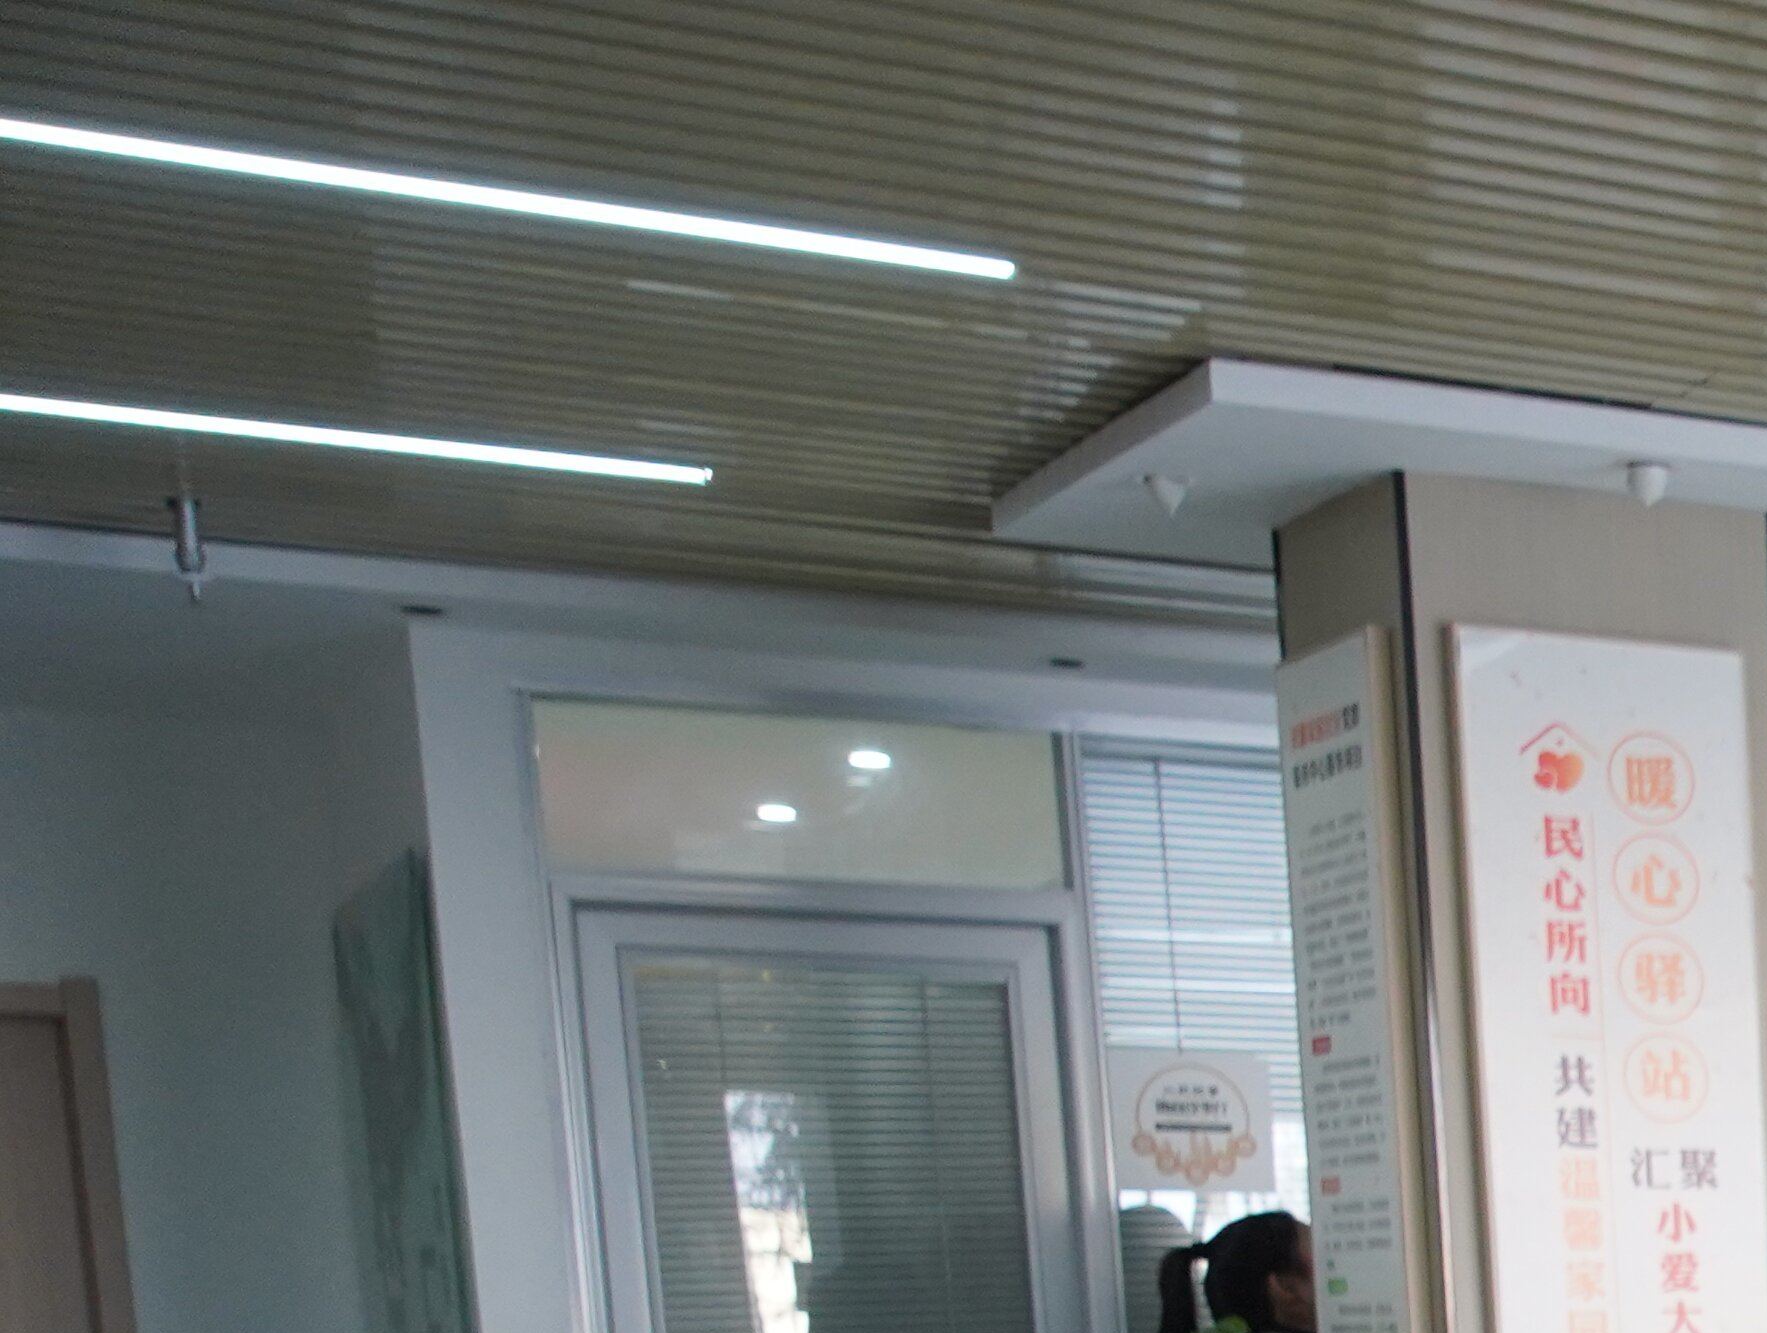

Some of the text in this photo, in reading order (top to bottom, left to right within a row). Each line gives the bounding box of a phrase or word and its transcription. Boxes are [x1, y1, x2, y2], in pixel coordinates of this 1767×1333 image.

[1543, 814, 1590, 1016] 民心所向
[1625, 756, 1692, 1102] 暖心驿站
